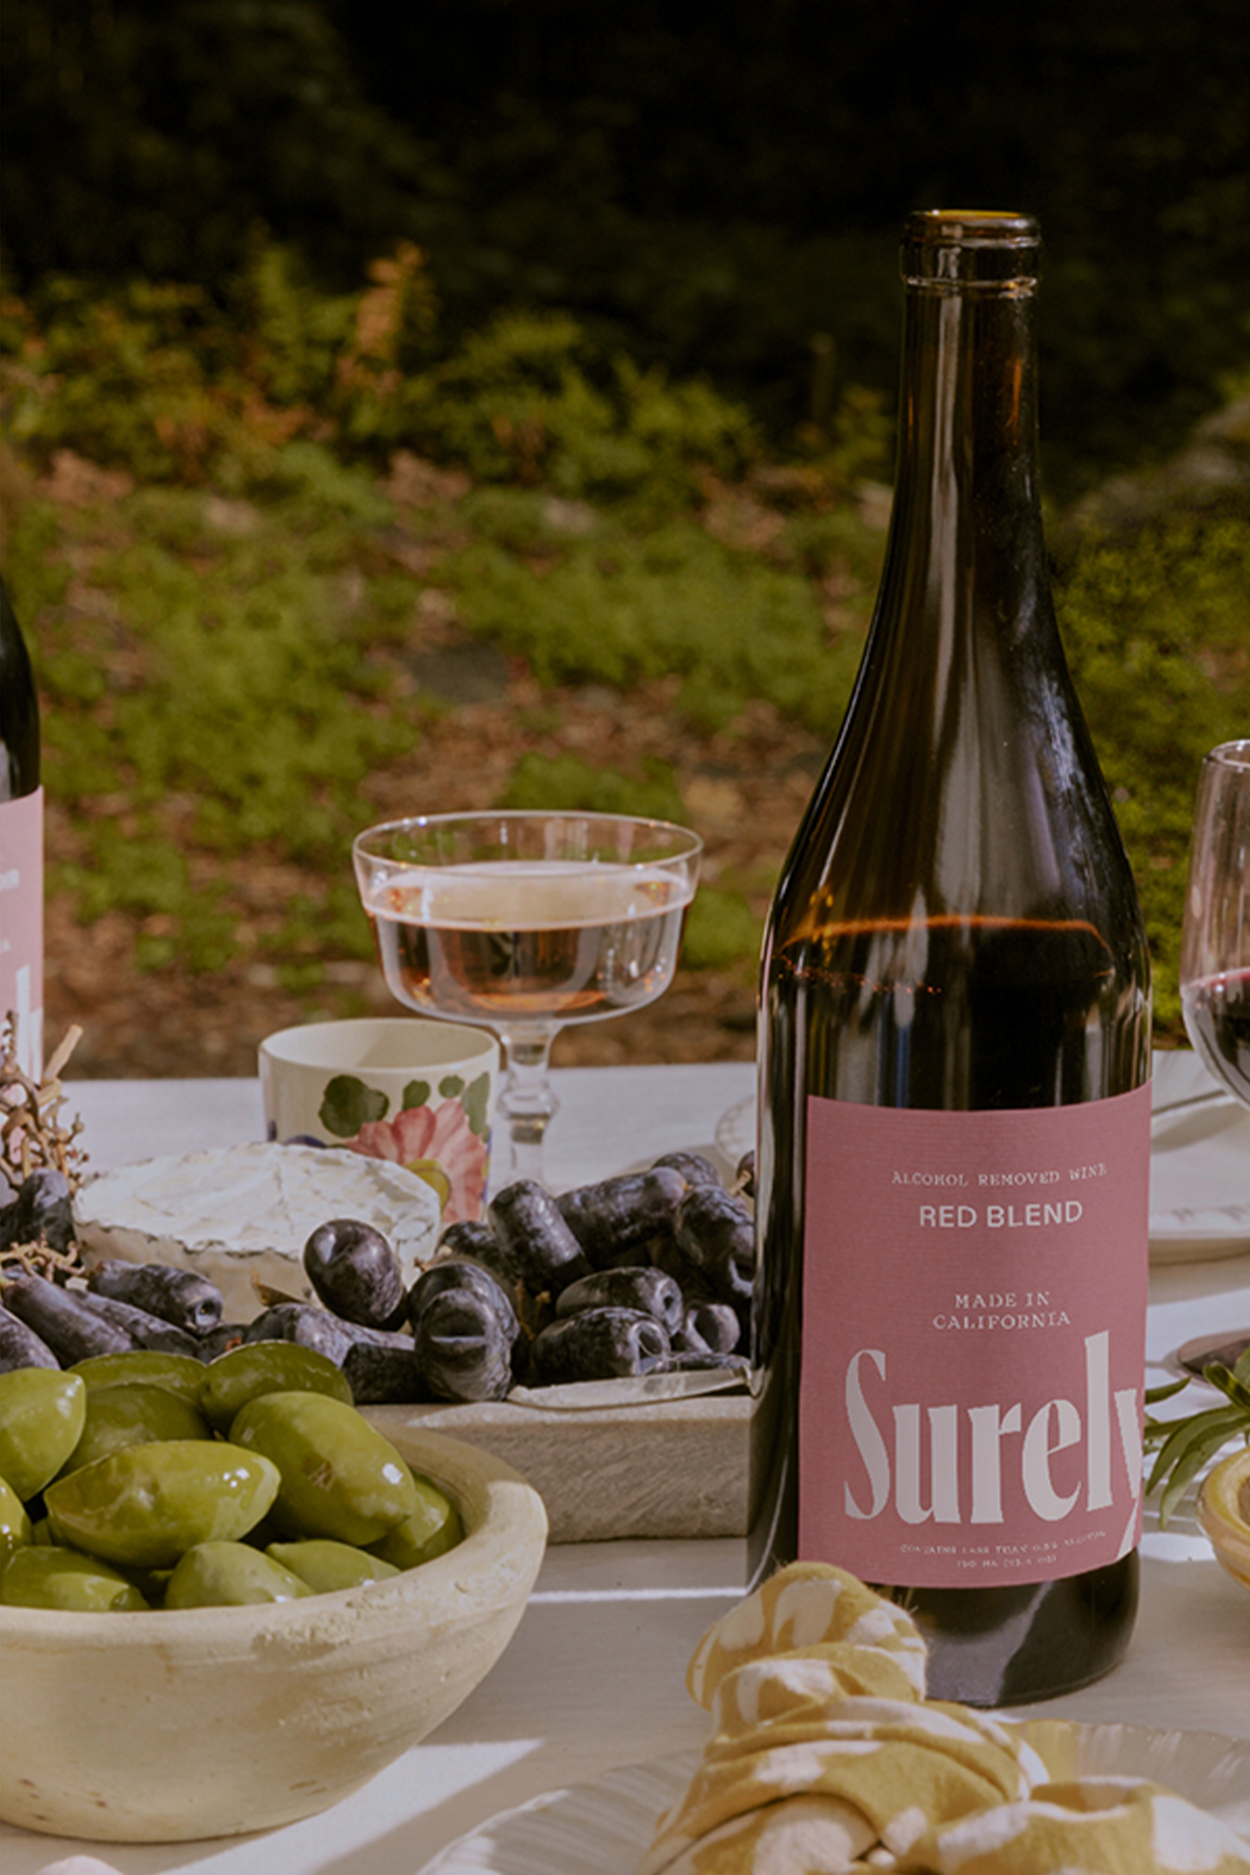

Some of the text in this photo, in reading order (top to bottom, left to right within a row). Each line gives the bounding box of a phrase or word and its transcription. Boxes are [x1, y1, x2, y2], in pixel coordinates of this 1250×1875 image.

[891, 1162, 1108, 1187] ALCOHOL REMOVED WINE
[919, 1200, 1083, 1228] RED BLEND
[955, 1290, 1050, 1309] MADE IN
[932, 1311, 1071, 1330] CALIFORNIA
